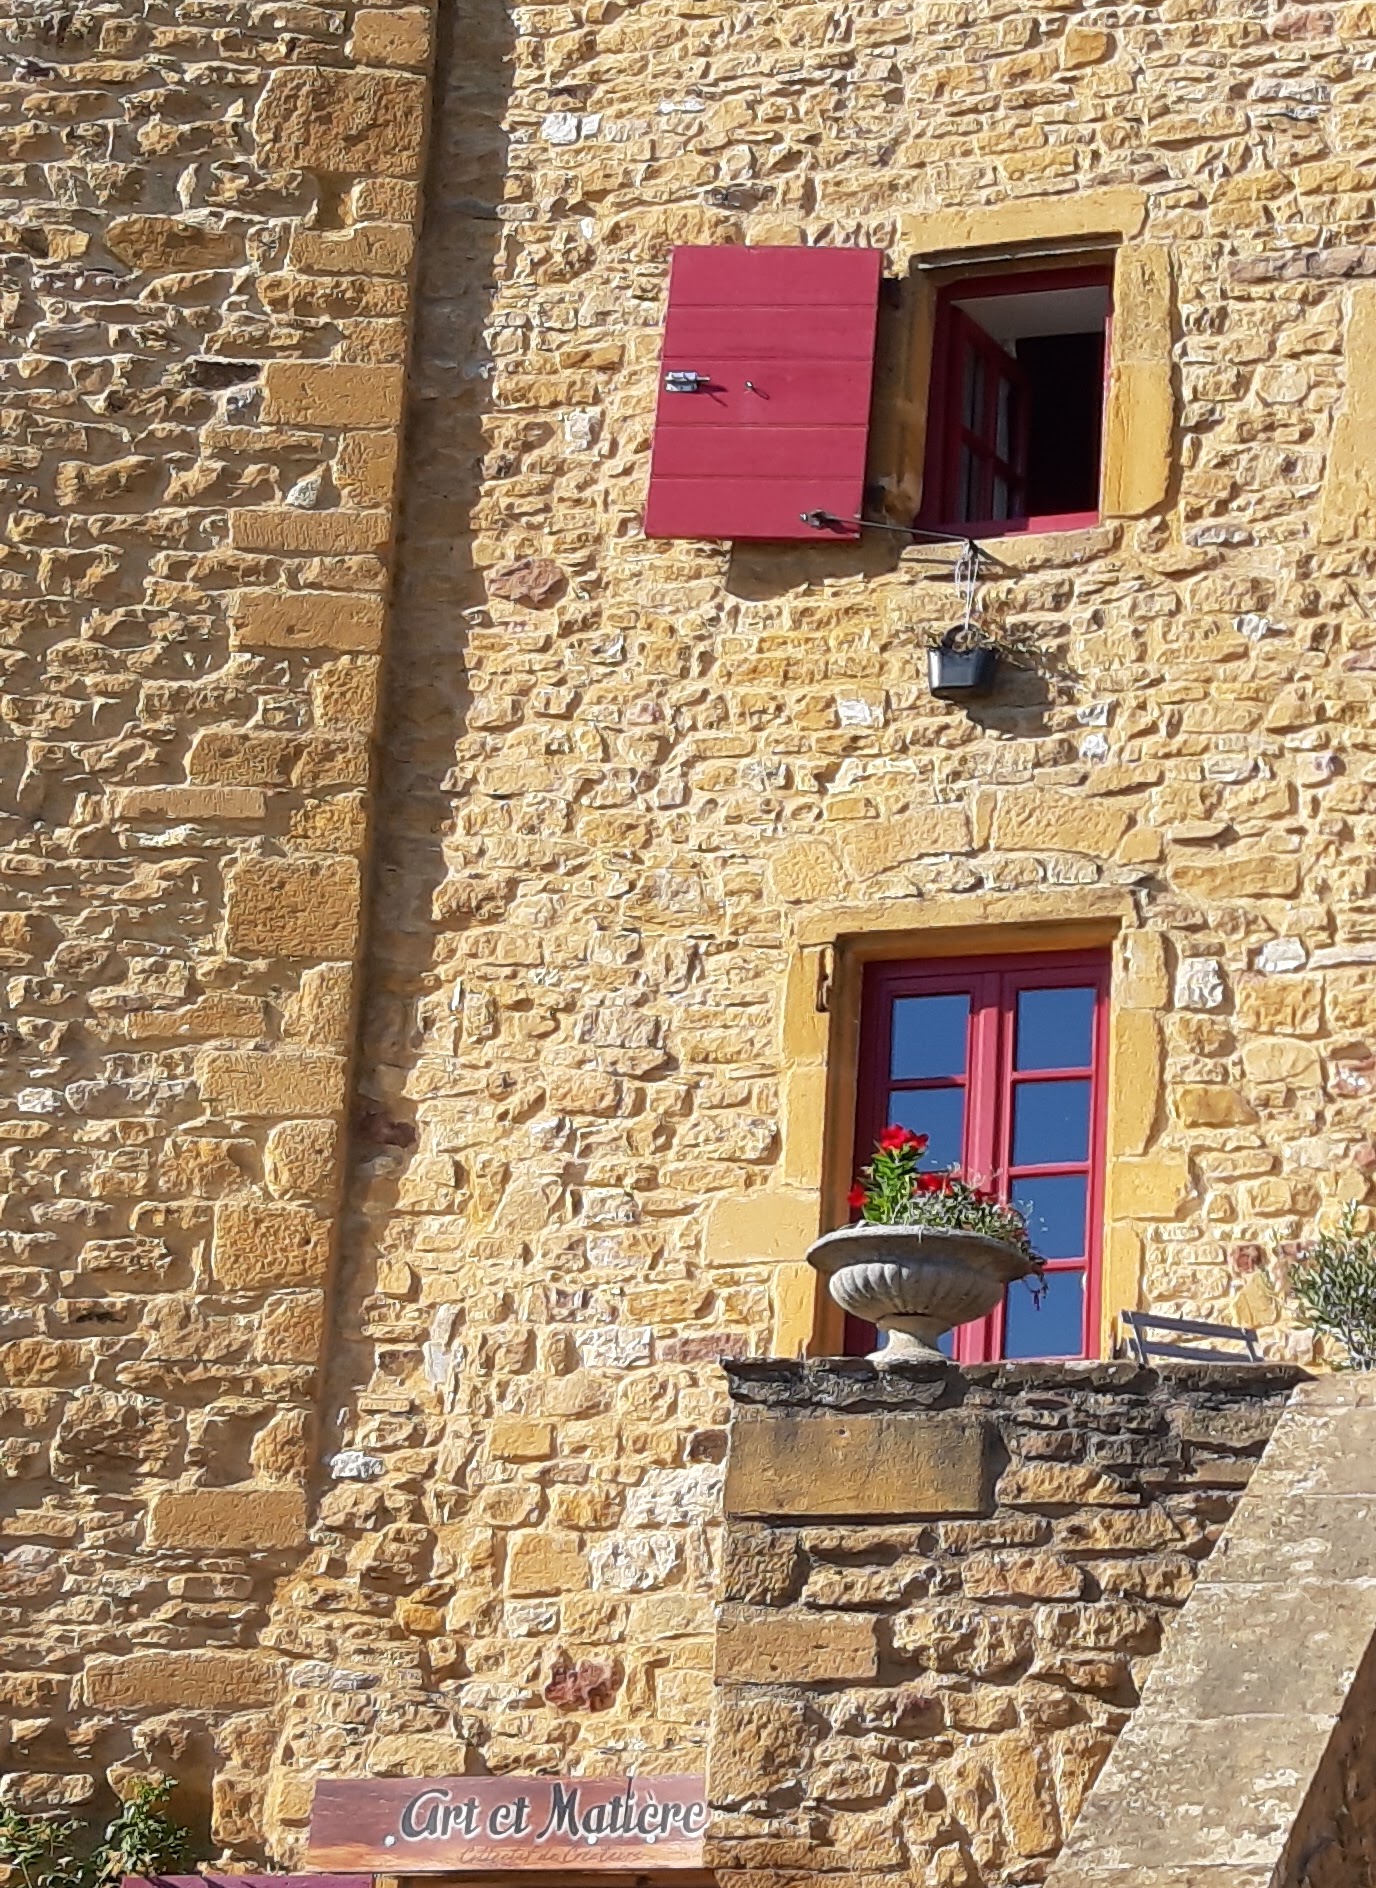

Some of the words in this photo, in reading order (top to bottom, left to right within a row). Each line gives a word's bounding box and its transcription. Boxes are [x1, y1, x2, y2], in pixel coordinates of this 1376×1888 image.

[401, 1788, 481, 1839] Art
[488, 1796, 531, 1836] et
[535, 1781, 708, 1840] Matière
